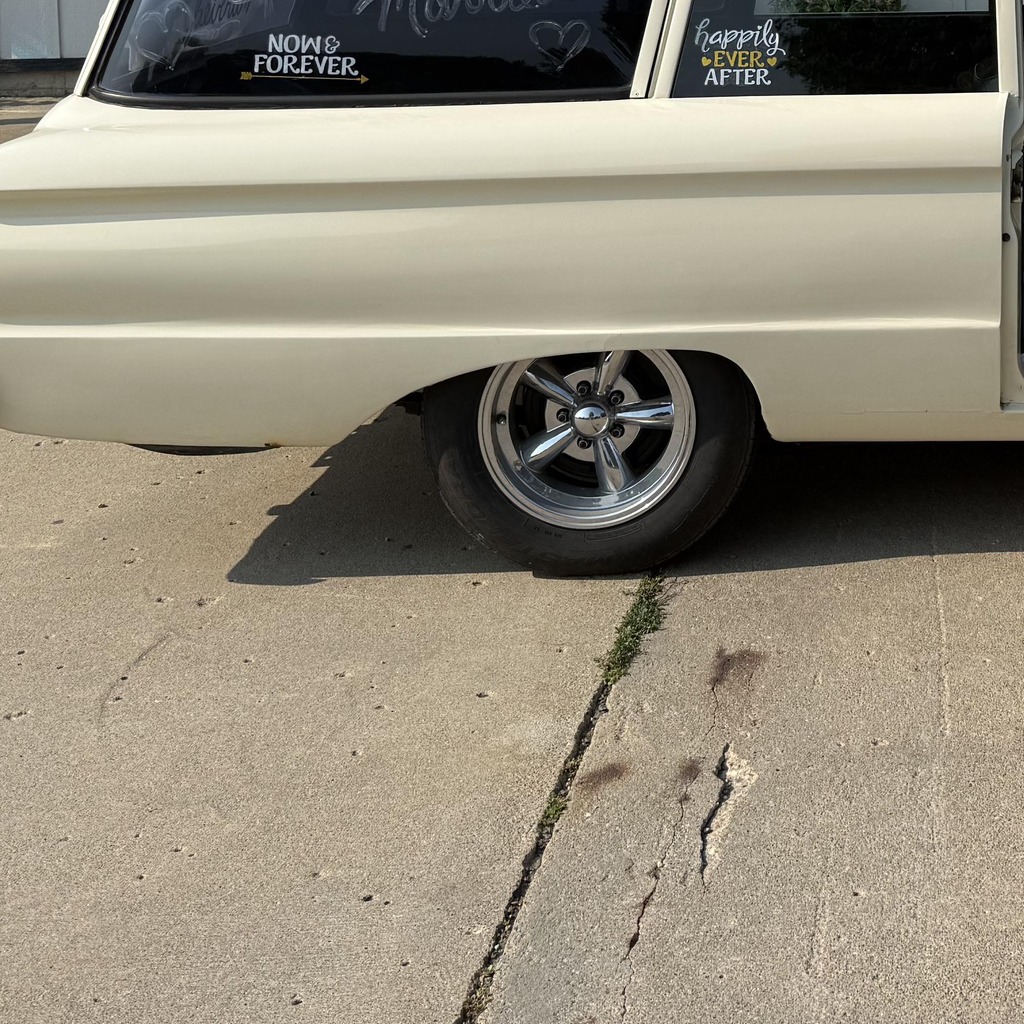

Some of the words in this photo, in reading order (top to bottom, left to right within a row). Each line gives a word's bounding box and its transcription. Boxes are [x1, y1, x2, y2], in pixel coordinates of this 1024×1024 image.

[267, 33, 322, 55] NOW
[324, 35, 341, 55] &
[694, 18, 786, 55] happily
[253, 54, 359, 76] FOREVER
[713, 50, 765, 68] EVER
[704, 67, 772, 86] AFTER
